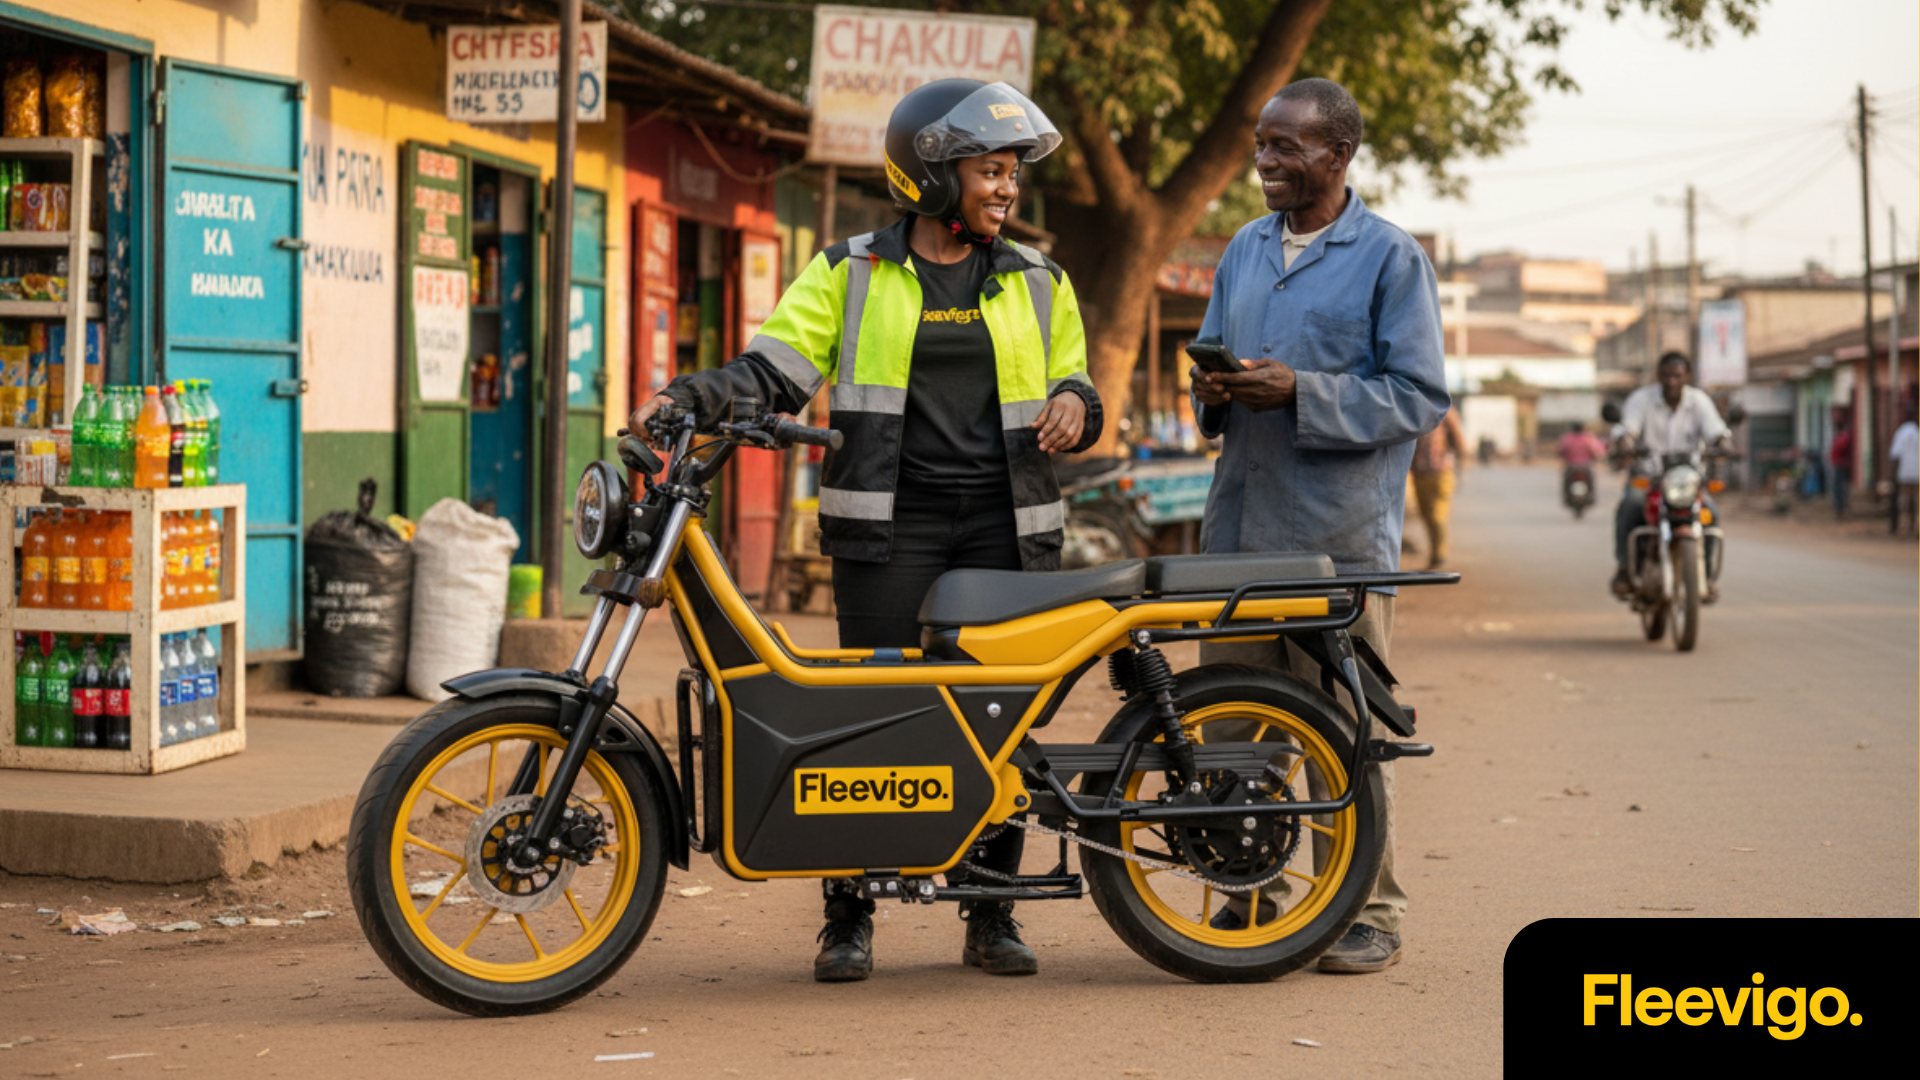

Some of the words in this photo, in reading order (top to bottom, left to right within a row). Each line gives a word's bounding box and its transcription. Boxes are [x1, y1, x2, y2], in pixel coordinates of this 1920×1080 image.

[825, 18, 1024, 75] CHAKULA
[203, 227, 233, 256] KA
[800, 771, 949, 809] Fleevigo.
